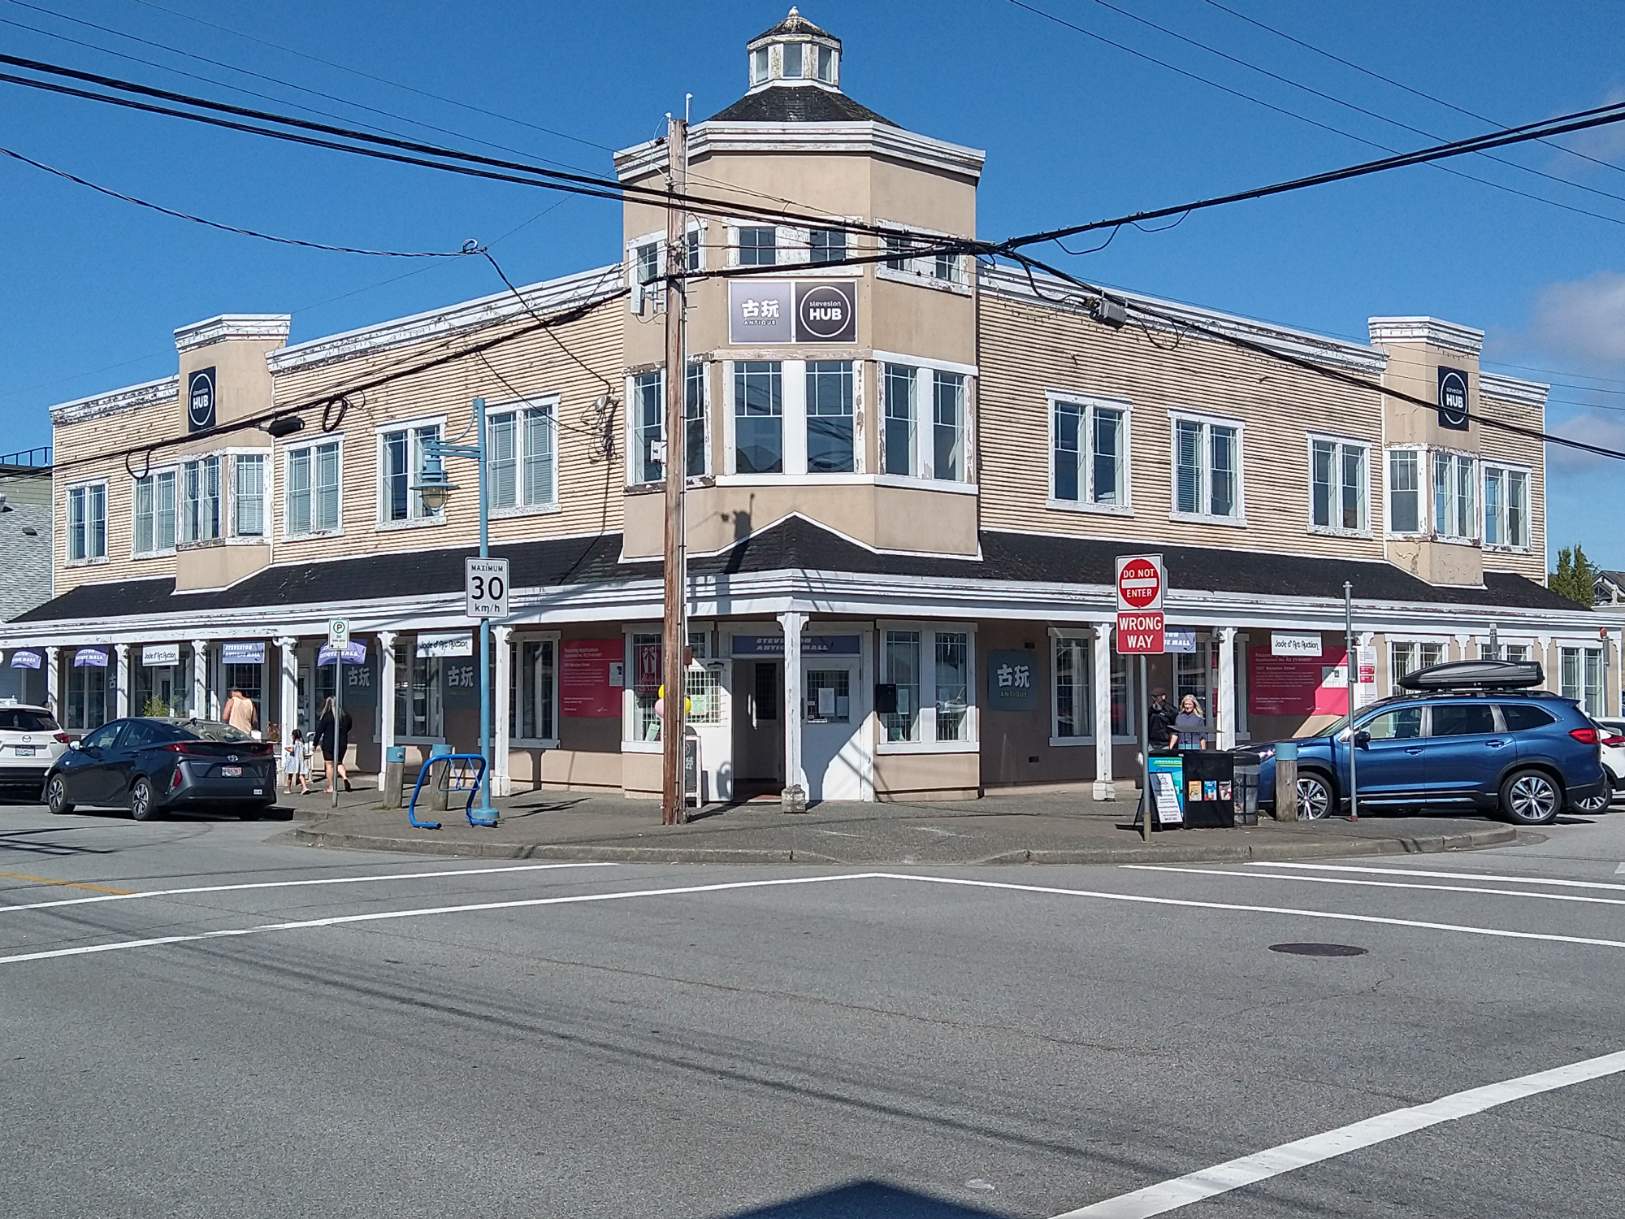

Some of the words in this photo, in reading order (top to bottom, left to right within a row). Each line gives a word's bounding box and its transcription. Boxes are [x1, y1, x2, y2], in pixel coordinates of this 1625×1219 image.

[742, 300, 779, 318] 古玩
[809, 308, 842, 320] HUB
[193, 395, 208, 409] HUB
[1446, 394, 1463, 408] HUB
[471, 564, 503, 572] MAXIMUM
[1123, 569, 1135, 578] DO
[1137, 568, 1155, 577] NOT
[471, 576, 504, 600] 30
[1126, 588, 1152, 598] ENTER
[474, 603, 501, 614] km/h
[1119, 617, 1162, 631] WRONG
[1127, 635, 1154, 649] WAY
[347, 666, 371, 687] 古玩
[447, 665, 474, 687] 古玩
[997, 663, 1030, 688] 古玩
